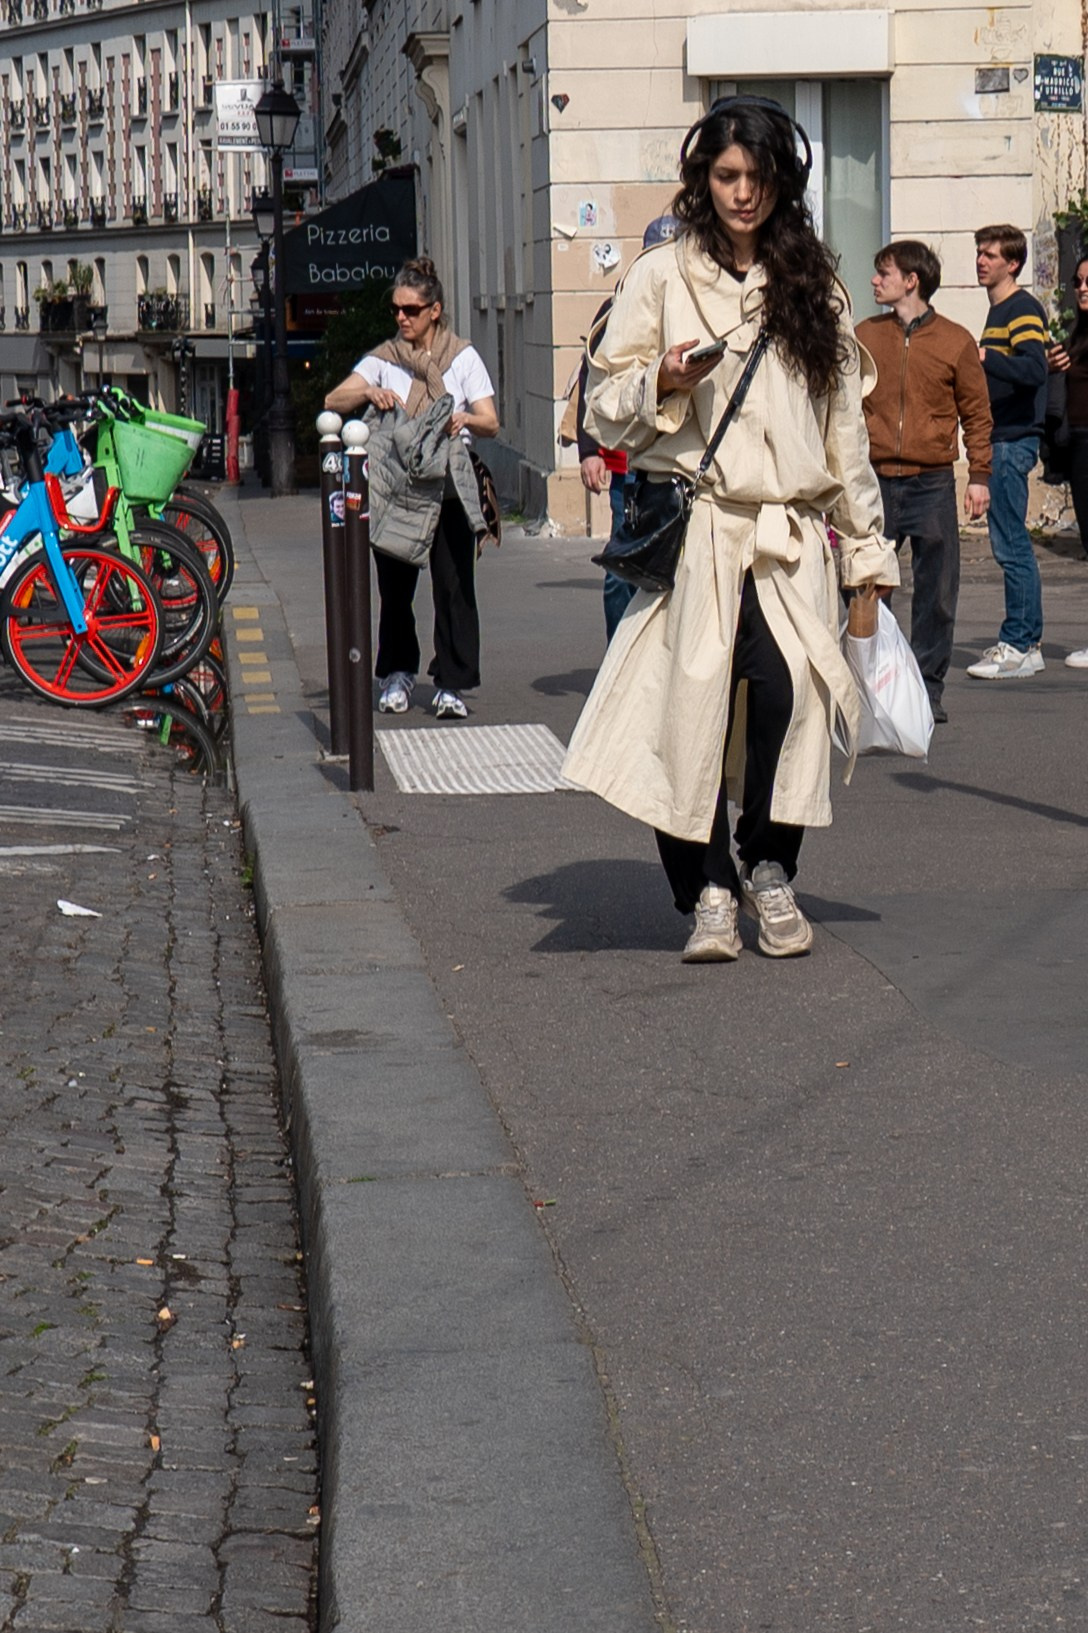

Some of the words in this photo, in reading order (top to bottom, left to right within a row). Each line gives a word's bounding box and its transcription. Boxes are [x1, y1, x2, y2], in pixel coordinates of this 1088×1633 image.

[1053, 67, 1065, 77] RUE
[1044, 76, 1074, 87] MAURICE
[1045, 86, 1073, 96] UTRILLO
[220, 122, 229, 130] 01
[231, 122, 241, 130] 55
[307, 223, 391, 246] Pizzeria
[308, 260, 396, 284] Babalou
